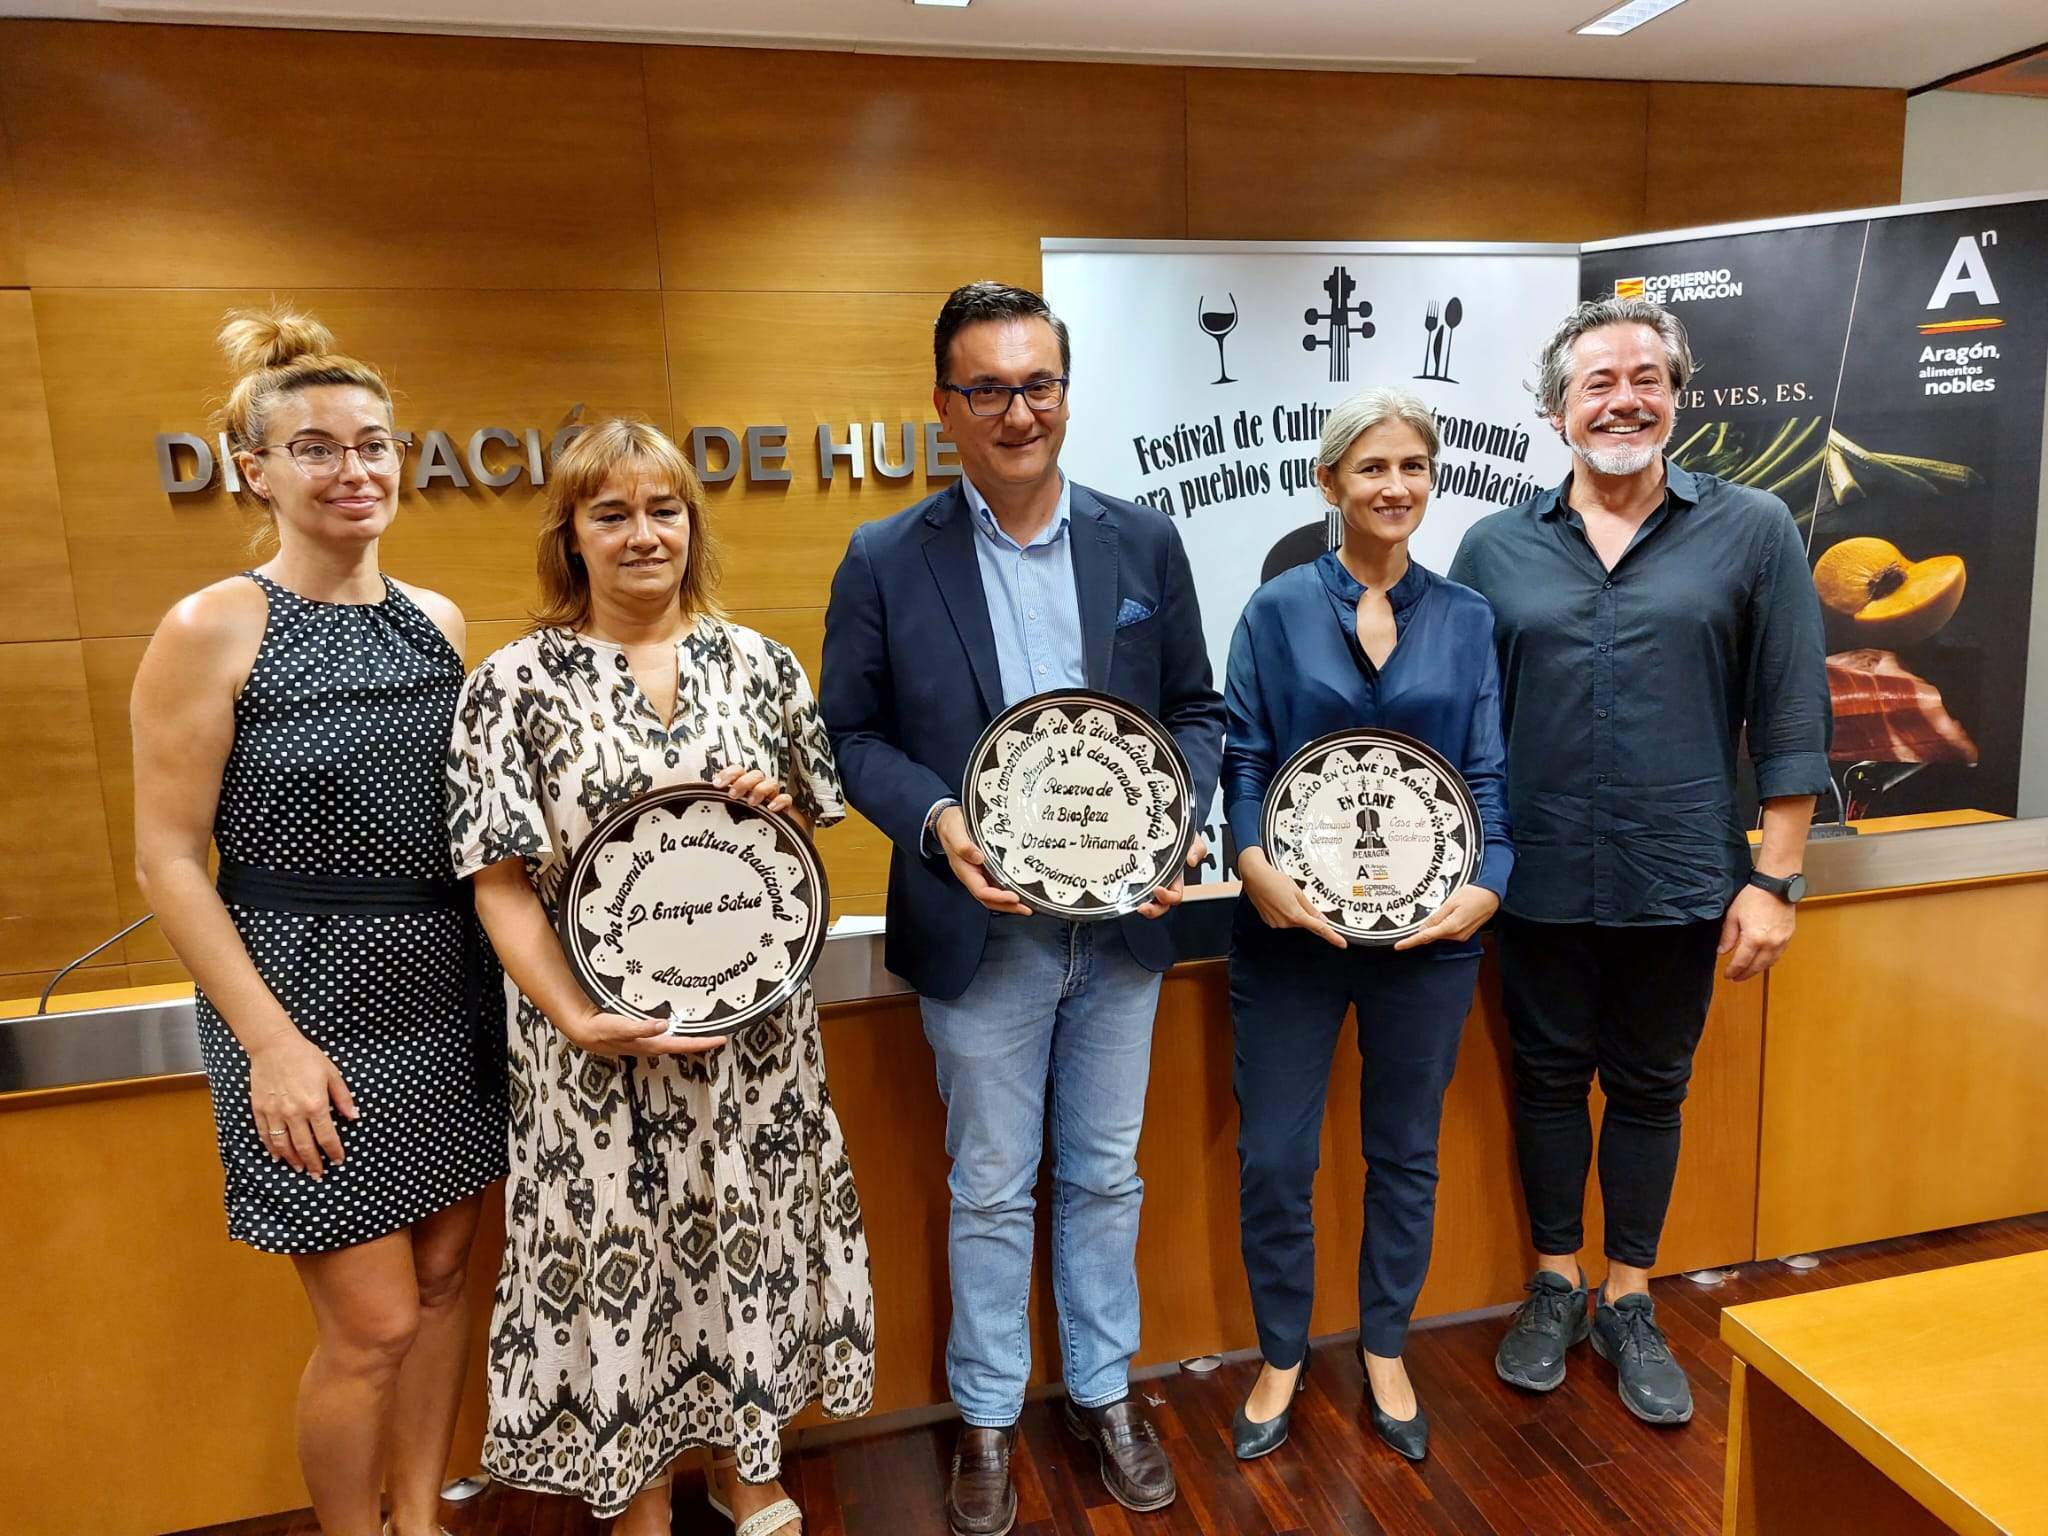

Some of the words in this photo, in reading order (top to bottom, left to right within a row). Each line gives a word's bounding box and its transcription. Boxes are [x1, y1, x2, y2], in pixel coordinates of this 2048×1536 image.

[1645, 269, 1731, 290] GOBIERNO
[1645, 290, 1667, 305] DE
[1919, 342, 2000, 365] Aragón,
[1919, 365, 1983, 379] alimentos
[1925, 375, 1995, 396] nobles
[1674, 390, 1705, 410] UE
[1713, 385, 1767, 406] VES,
[1776, 383, 1814, 402] ES.
[693, 425, 792, 482] DE
[816, 421, 963, 479] HUE
[1133, 415, 1226, 475] Festival
[1233, 410, 1264, 450] de
[1272, 402, 1331, 443] Cultu
[1431, 407, 1530, 463] ronomía
[1134, 486, 1176, 516] ara
[1179, 460, 1271, 519] pueblos
[1279, 456, 1318, 496] que
[1436, 461, 1545, 507] població
[997, 727, 1049, 792] conservación
[1052, 719, 1069, 735] de
[1073, 721, 1085, 736] la
[1044, 777, 1093, 797] Reserva
[1096, 781, 1113, 797] de
[1057, 748, 1069, 766] y
[1070, 740, 1085, 757] el
[1087, 746, 1142, 806] desarrollo
[1323, 769, 1339, 783] EN
[1342, 763, 1379, 775] CLAVE
[1382, 765, 1399, 779] DE
[1400, 776, 1439, 814] ARAGÓN
[1337, 795, 1355, 811] EN
[1358, 792, 1396, 809] CLAVE
[1042, 804, 1055, 821] la
[1057, 806, 1109, 827] Biosfera
[1389, 816, 1411, 827] Casa
[1414, 817, 1426, 828] de
[660, 832, 676, 853] la
[681, 829, 738, 855] cultura
[1021, 832, 1067, 849] Ordesa
[606, 850, 655, 919] transmitir
[738, 845, 793, 922] tradicional
[1024, 855, 1087, 888] económico
[1103, 853, 1139, 885] social
[1298, 862, 1314, 877] SU
[1311, 877, 1382, 913] TRAYECTORIA
[1386, 831, 1446, 911] AGROALIMENTARIA
[652, 902, 712, 925] Enrique
[718, 891, 763, 912] Satué
[603, 920, 623, 953] Por
[651, 952, 758, 996] altoaragonesa
